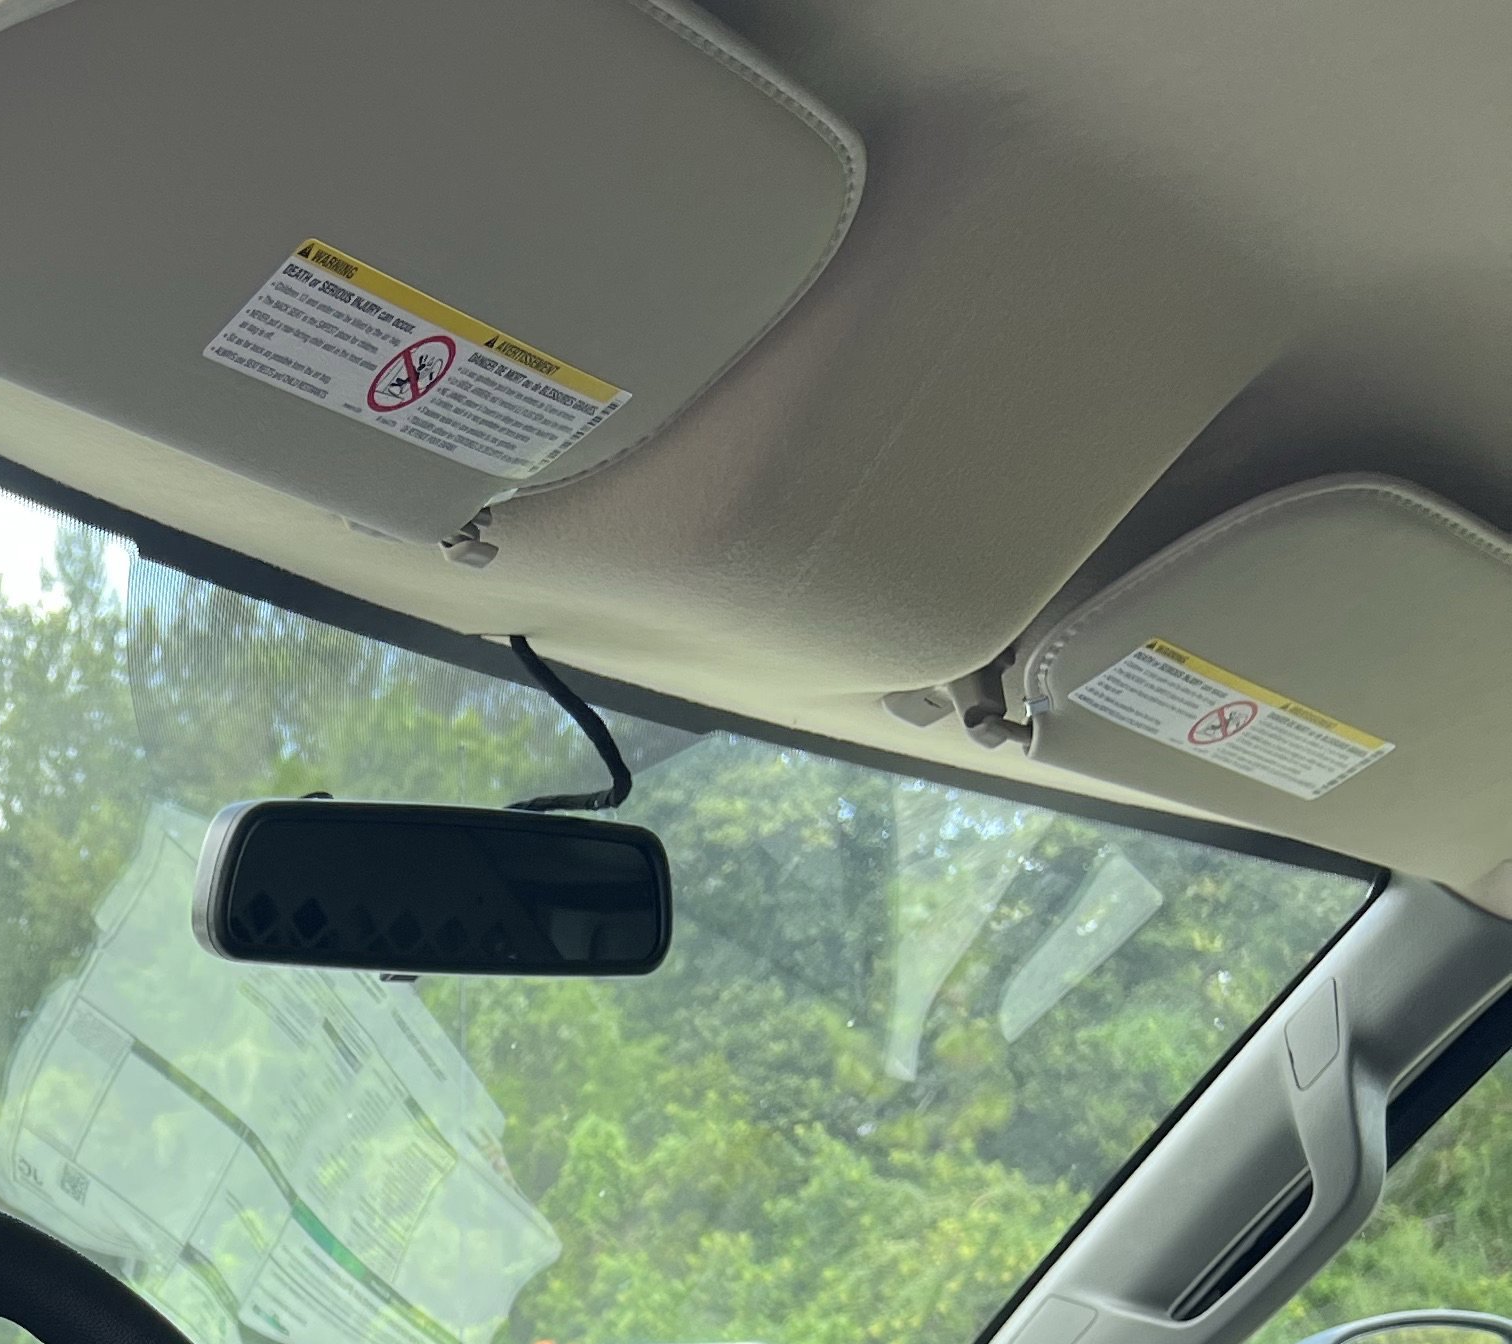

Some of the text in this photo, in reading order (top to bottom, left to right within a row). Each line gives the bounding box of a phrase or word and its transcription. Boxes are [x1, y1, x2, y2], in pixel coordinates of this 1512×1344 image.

[311, 248, 359, 280] WARNING
[282, 263, 314, 284] DEATH
[318, 280, 356, 304] SERIOUS
[350, 295, 383, 317] INJURY
